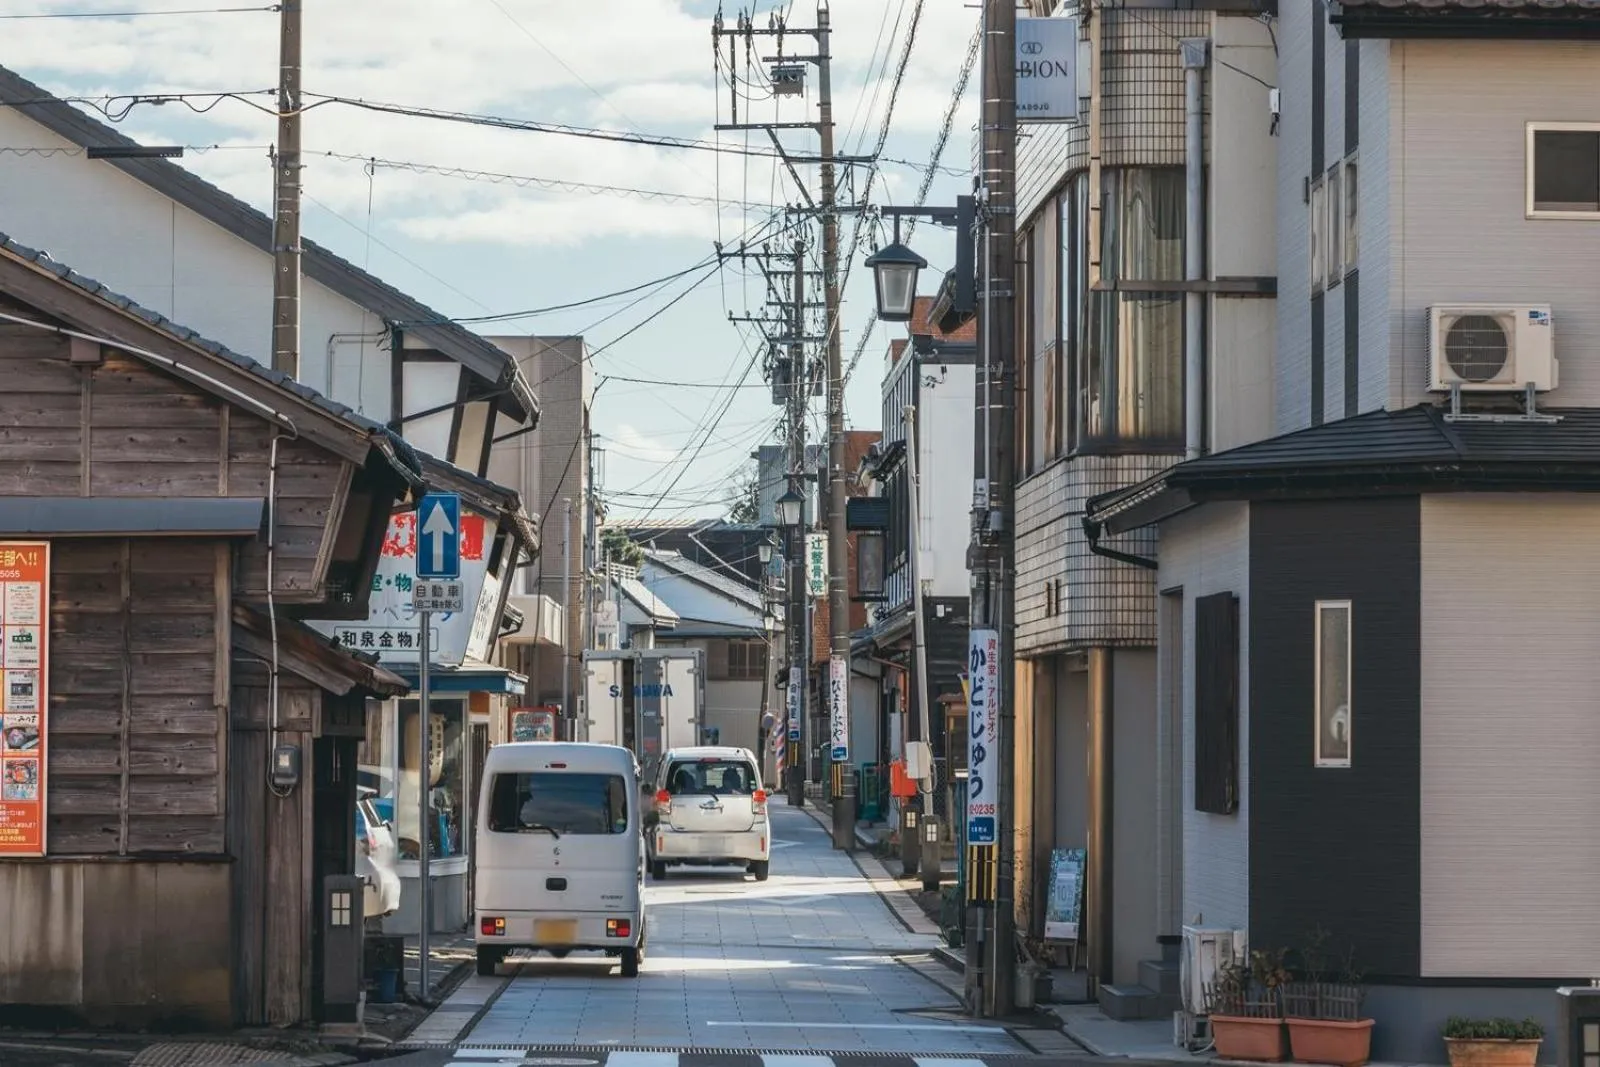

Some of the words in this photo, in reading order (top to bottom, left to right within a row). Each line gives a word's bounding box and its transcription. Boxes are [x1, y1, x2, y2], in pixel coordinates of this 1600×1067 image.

[1015, 61, 1067, 78] BION
[416, 584, 459, 597] 自動車
[971, 644, 987, 799] かどじゅう
